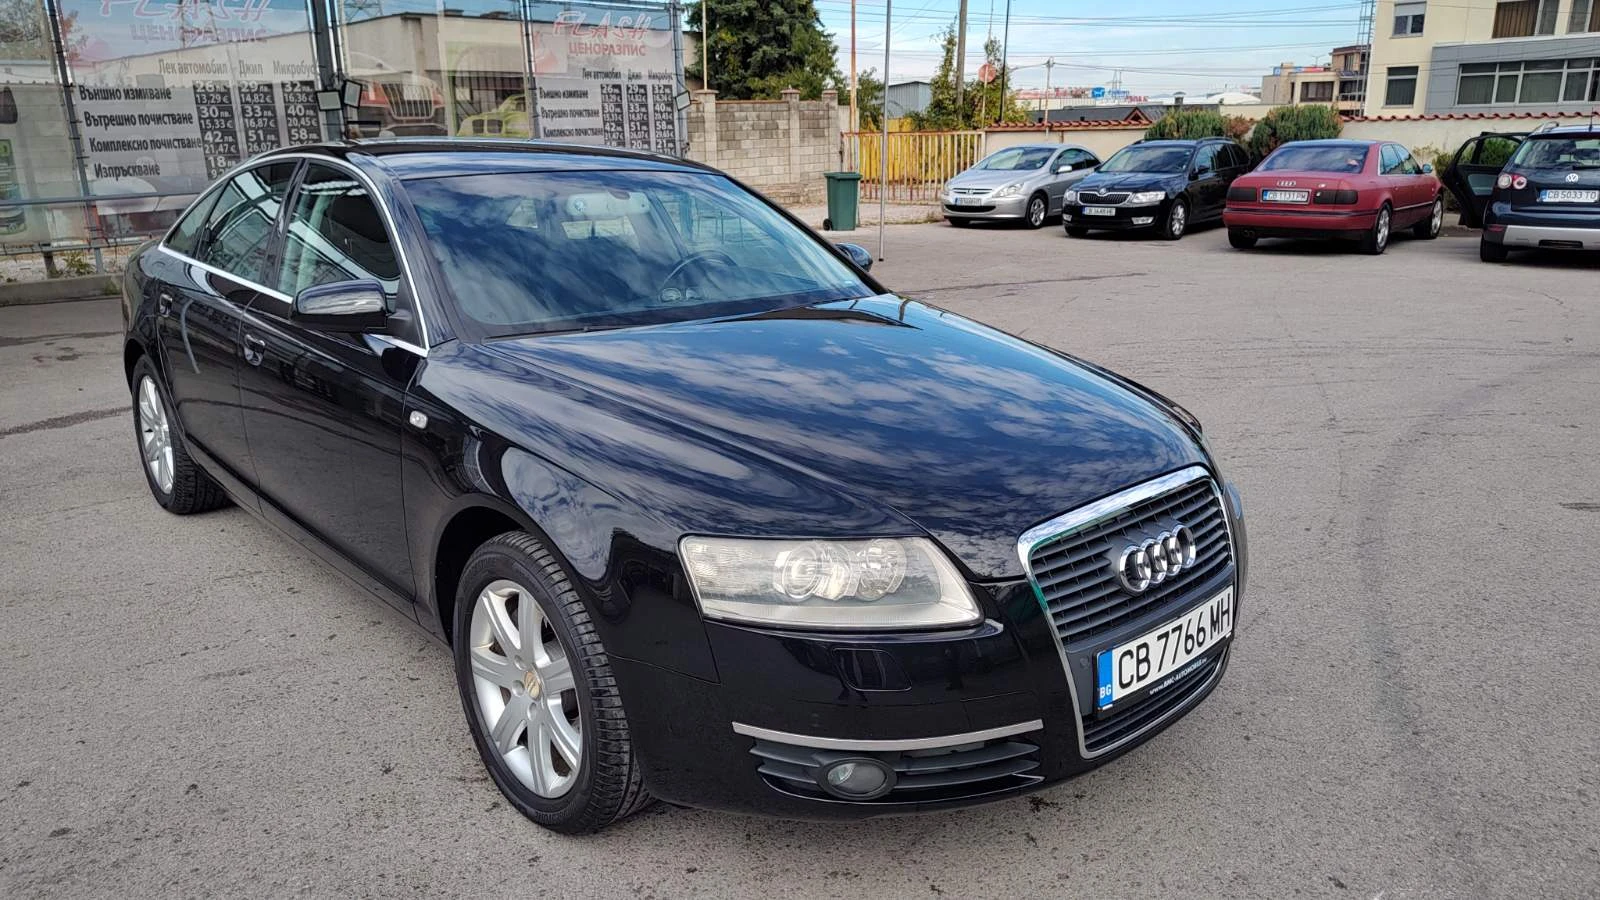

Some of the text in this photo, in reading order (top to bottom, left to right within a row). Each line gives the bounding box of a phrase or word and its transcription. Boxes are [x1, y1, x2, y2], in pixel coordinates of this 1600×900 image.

[553, 10, 652, 39] FLASH
[569, 42, 647, 57] ЦЕНОРАЗПИС
[178, 59, 227, 74] автомобил
[240, 81, 258, 92] 29
[283, 81, 301, 92] 32
[602, 85, 613, 93] 26
[628, 85, 639, 93] 29
[79, 85, 172, 100] Външно измиване
[200, 106, 219, 118] 30
[244, 106, 261, 117] 33
[287, 106, 305, 116] 40
[604, 104, 615, 112] 30
[629, 104, 640, 112] 33
[654, 103, 666, 112] 40
[84, 111, 194, 131] Вътрешно почистване
[200, 119, 226, 129] 15,33
[288, 117, 311, 127] 20,45
[605, 122, 616, 131] 42
[630, 122, 641, 131] 51
[655, 121, 667, 130] 58
[204, 131, 223, 142] 42
[248, 130, 264, 141] 51
[291, 129, 308, 140] 58
[89, 138, 203, 152] Комплексно почистване
[205, 144, 229, 154] 21,47
[209, 157, 227, 168] 18
[94, 163, 161, 181] Изпръскване
[1548, 190, 1559, 199] CB
[1118, 593, 1231, 690] CB 7766 MH
[1099, 684, 1112, 698] BG
